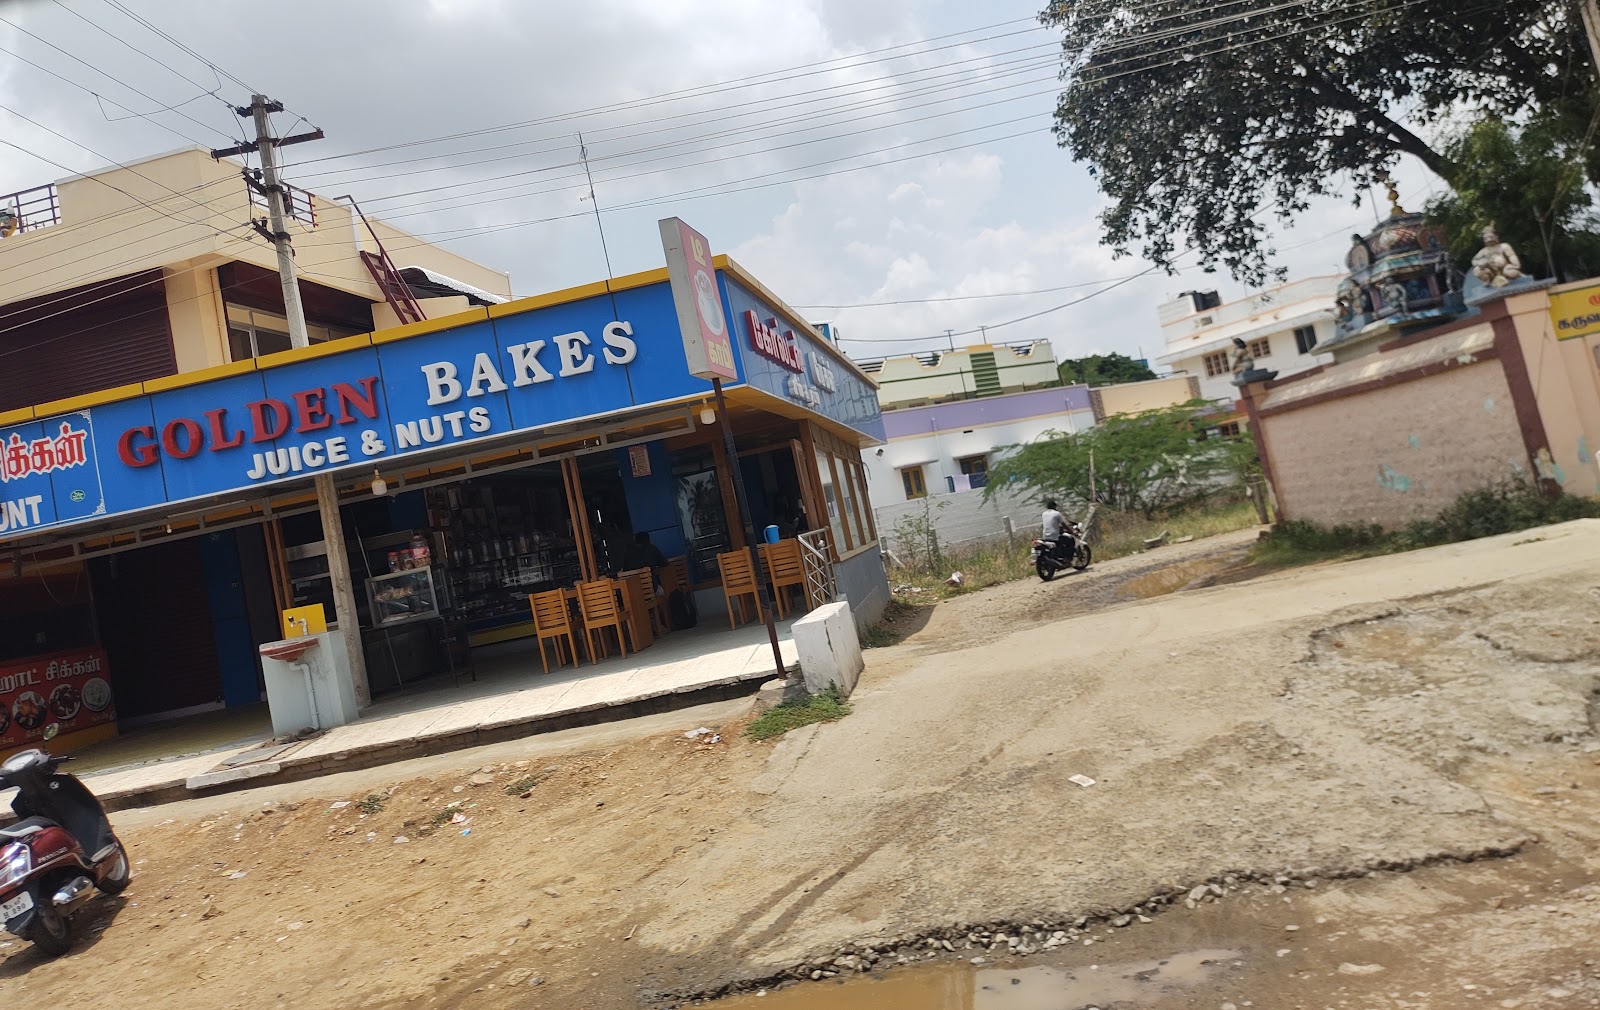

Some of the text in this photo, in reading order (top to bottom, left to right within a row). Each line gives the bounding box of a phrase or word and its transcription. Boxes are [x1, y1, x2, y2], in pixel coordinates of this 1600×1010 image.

[117, 320, 638, 469] GOLDEN BAKES
[247, 407, 492, 480] JUICE & NUTS
[46, 655, 101, 680] சிக்கன்
